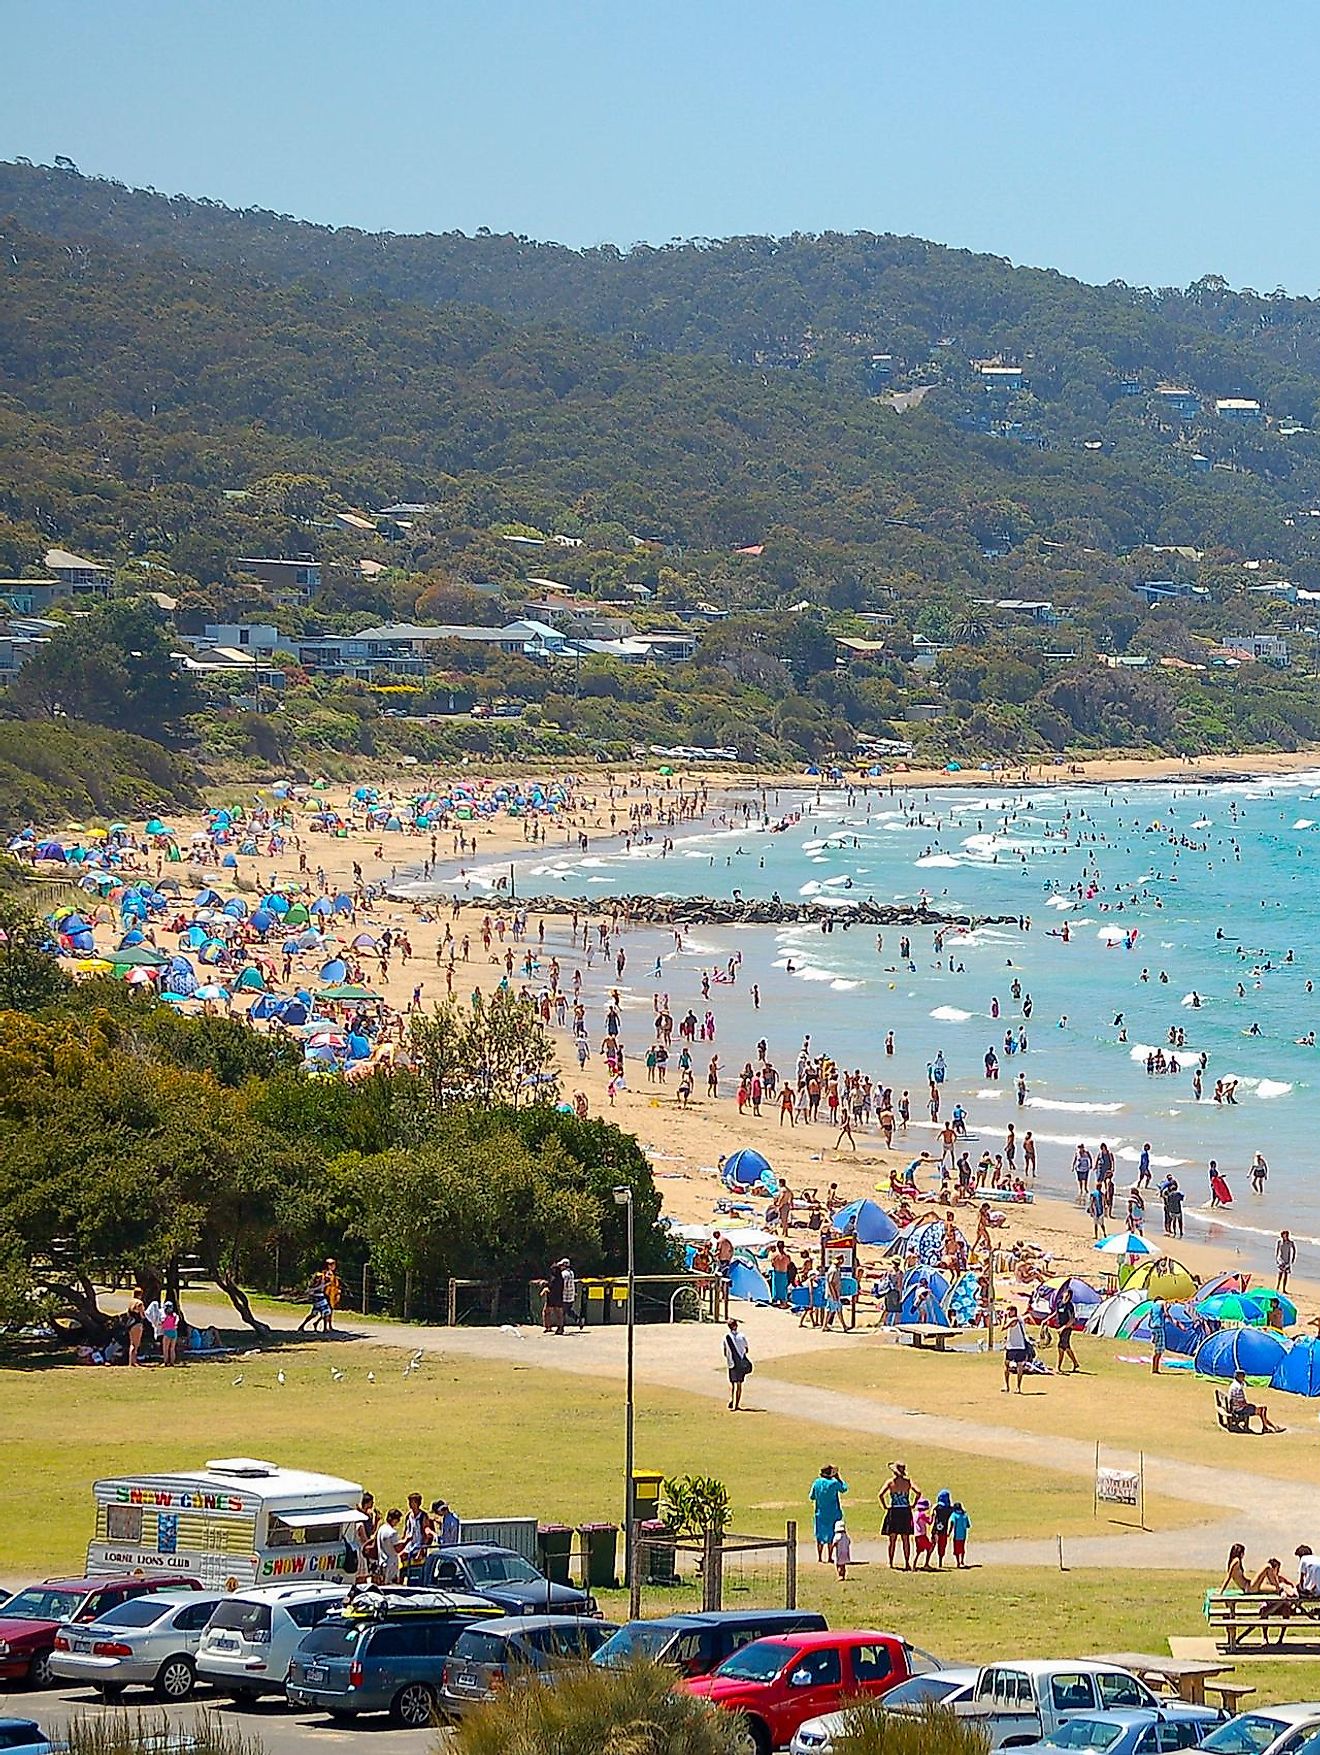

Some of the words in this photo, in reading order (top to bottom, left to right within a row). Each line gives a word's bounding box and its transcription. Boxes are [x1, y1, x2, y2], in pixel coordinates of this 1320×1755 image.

[116, 1487, 173, 1507] SNOW
[180, 1491, 244, 1511] CONES
[104, 1552, 133, 1563] LORNE
[137, 1555, 164, 1566] LIONS
[168, 1557, 190, 1567] CLUB
[262, 1556, 306, 1576] SNOW
[309, 1553, 346, 1571] CONE
